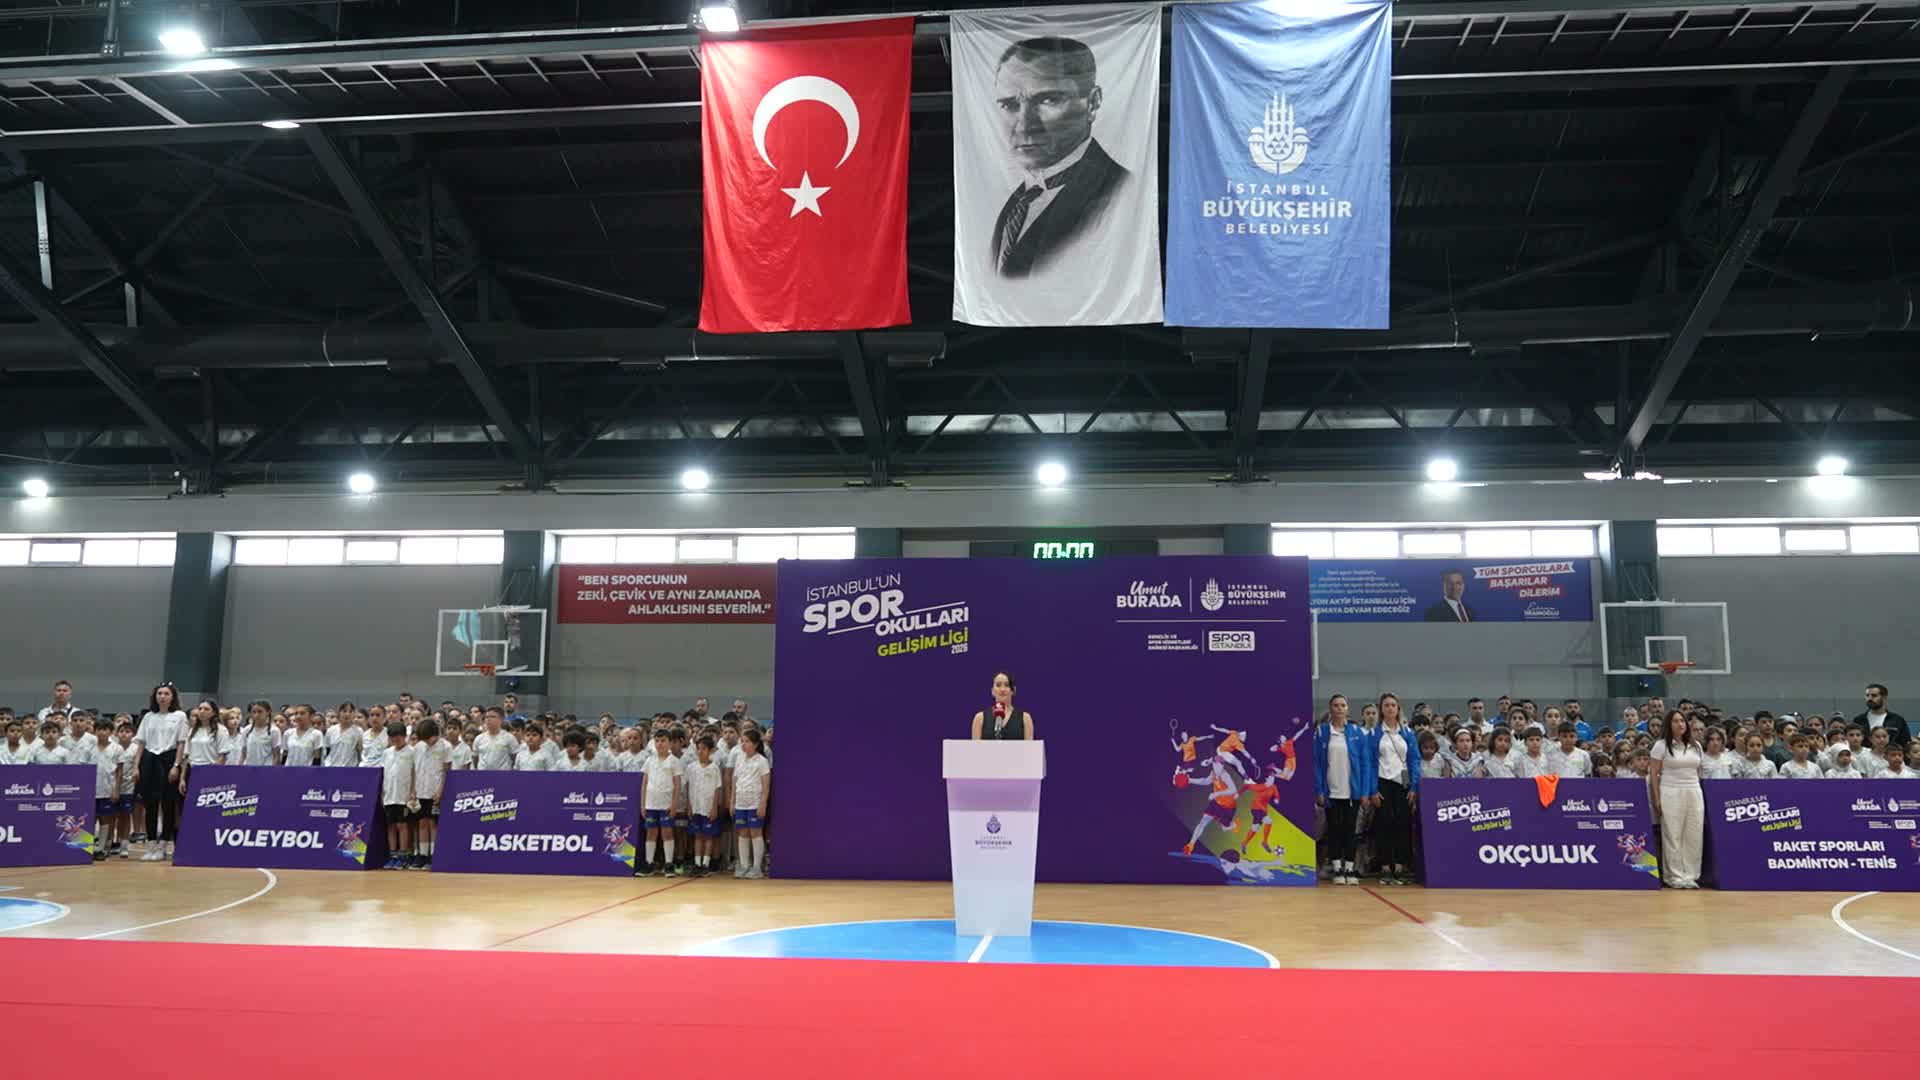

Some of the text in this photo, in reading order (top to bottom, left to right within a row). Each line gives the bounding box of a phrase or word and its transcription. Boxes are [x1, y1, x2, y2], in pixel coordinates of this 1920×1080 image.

[1227, 180, 1329, 195] İSTANBUL
[1203, 197, 1352, 220] BÜYÜKŞEHİR
[1226, 223, 1329, 235] BELEDİYESİ
[1479, 563, 1570, 576] TÜM SPORCULARA
[611, 574, 687, 585] SPORCUNUN
[1489, 576, 1548, 588] BAŞARILAR
[577, 588, 761, 601] ZEKİ, ÇEVİK VE AYNI ZAMANDA
[806, 573, 901, 602] İSTANBUL'UN
[1130, 580, 1168, 595] Umut
[1519, 587, 1560, 598] DİLERİM
[1116, 595, 1182, 608] BURADA
[1227, 590, 1286, 600] BÜYÜKŞEHİR
[628, 604, 705, 615] AHLAKLISINI
[802, 589, 905, 633] SPOR
[875, 606, 969, 636] OKULLARI
[877, 627, 968, 657] GELİŞİM LİGİ
[1212, 633, 1251, 642] SPOR
[196, 790, 237, 806] SPOR
[453, 794, 494, 812] SPOR
[1436, 801, 1481, 822] SPOR
[1470, 809, 1511, 823] OKULLARI
[1725, 801, 1770, 821] SPOR
[1758, 809, 1801, 823] OKULLARI
[214, 828, 324, 849] VOLEYBOL
[470, 834, 593, 852] BASKETBOL
[1773, 841, 1885, 852] RAKET SPORLARI
[1478, 844, 1599, 868] OKÇULUK
[1768, 855, 1849, 869] BADMİNTON
[1857, 855, 1897, 869] TENİS
